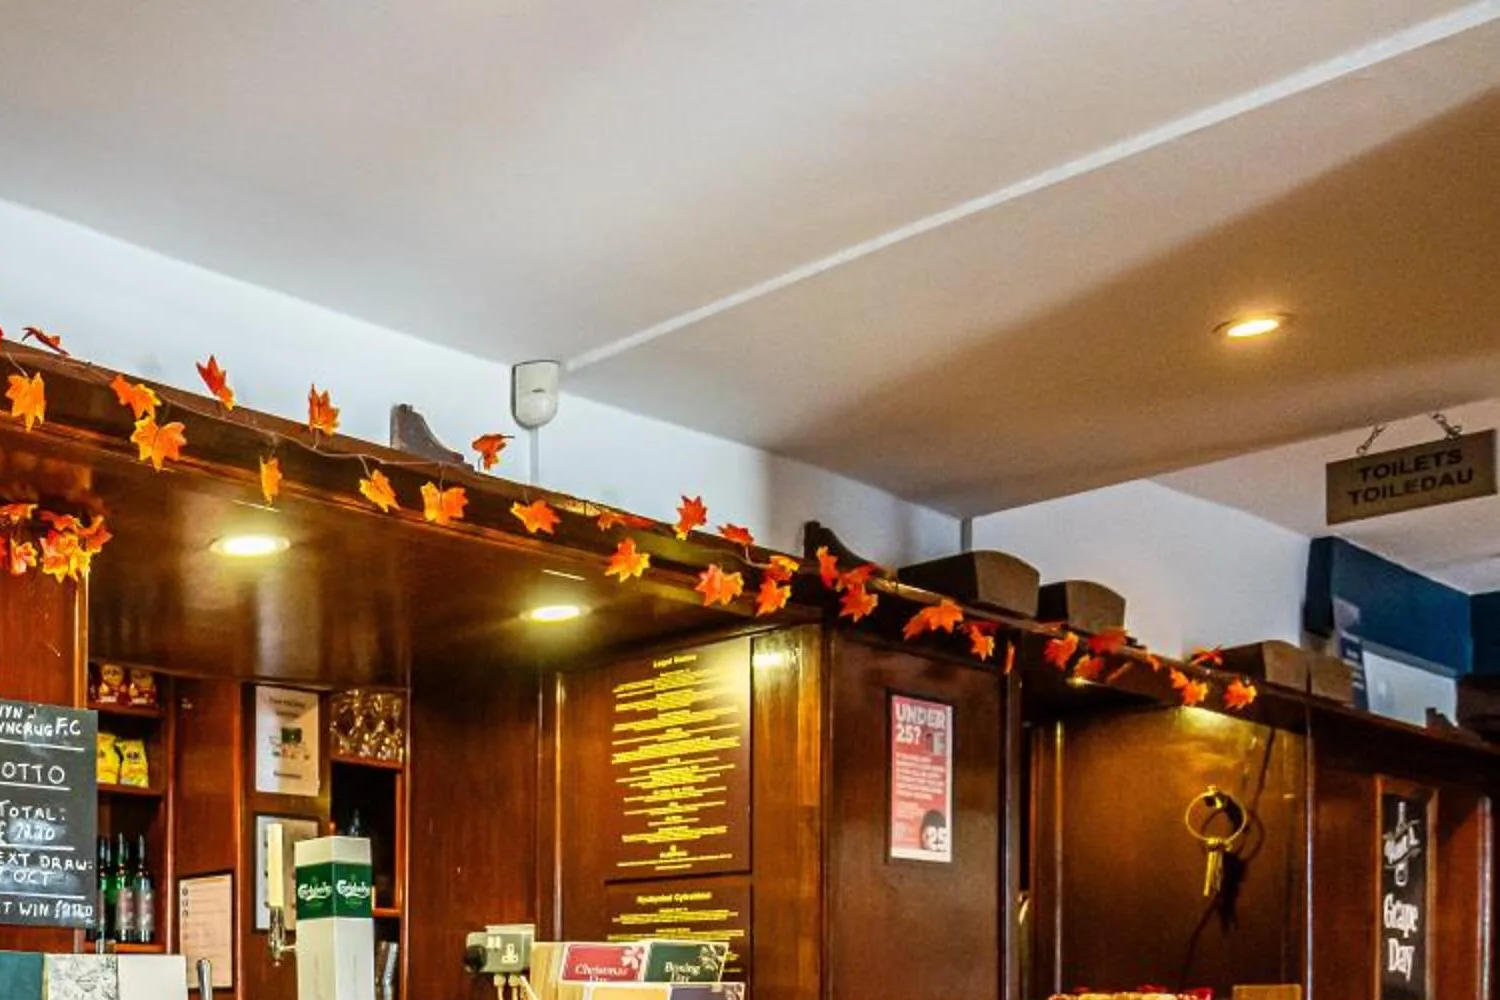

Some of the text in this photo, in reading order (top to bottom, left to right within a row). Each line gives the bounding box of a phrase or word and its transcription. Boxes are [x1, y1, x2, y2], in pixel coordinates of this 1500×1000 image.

[1358, 449, 1463, 482] TOILETS
[1348, 467, 1474, 505] TOILEDAU
[895, 703, 946, 730] UNDER
[895, 722, 922, 745] 25?
[13, 868, 54, 886] OCT
[19, 902, 49, 918] WIN
[1384, 893, 1419, 939] Grape
[575, 963, 628, 976] Christmas
[664, 961, 700, 976] Boxing
[1388, 937, 1415, 982] Day
